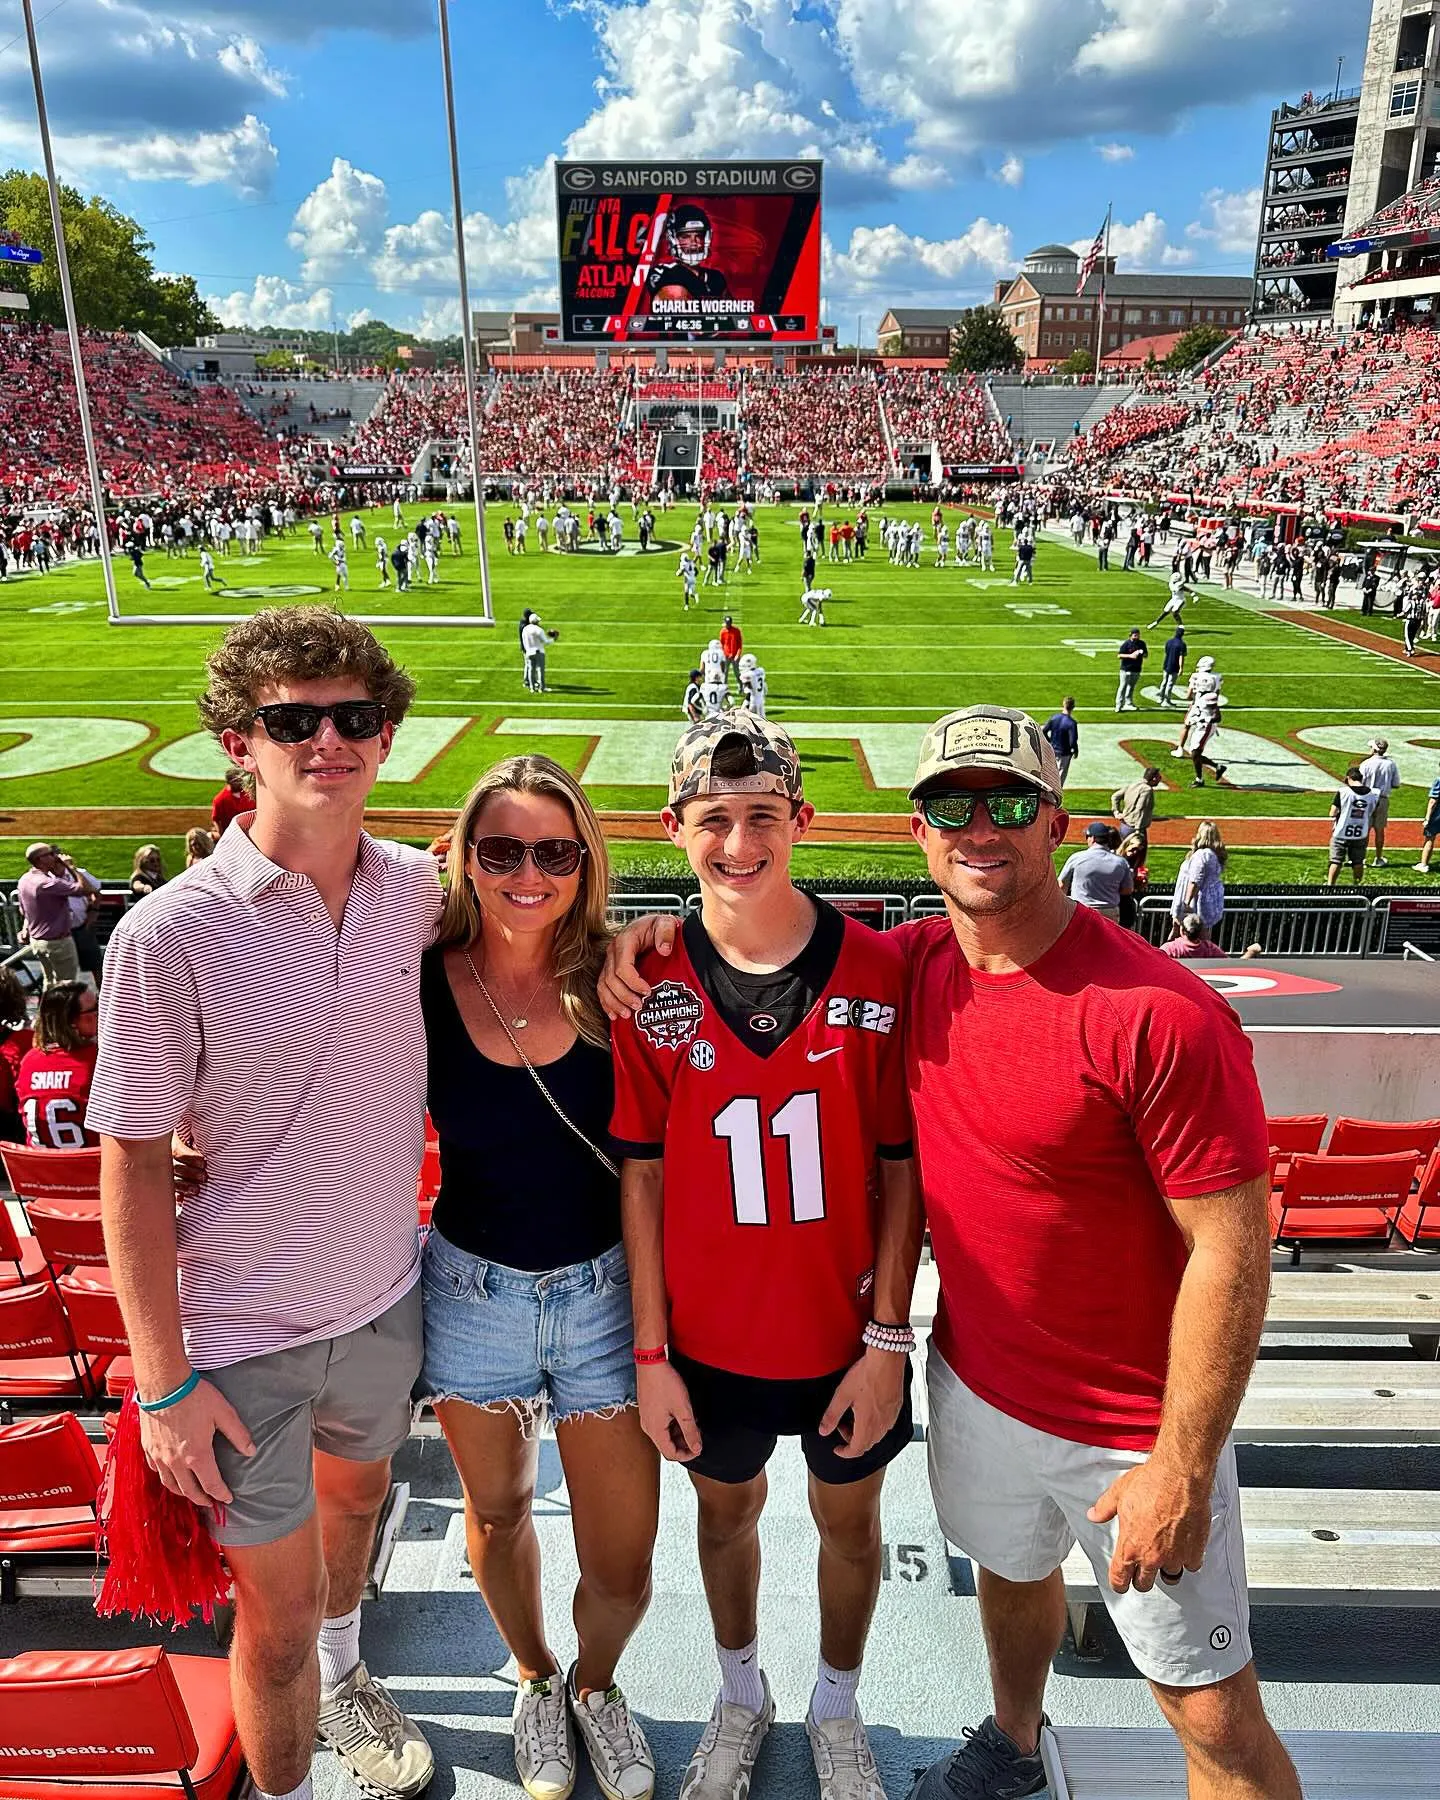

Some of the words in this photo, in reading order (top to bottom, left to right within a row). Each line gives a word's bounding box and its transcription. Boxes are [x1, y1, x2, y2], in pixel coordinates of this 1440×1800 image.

[602, 171, 687, 186] SANFORD
[696, 170, 776, 185] STADIUM
[568, 198, 620, 214] ATLANTA
[576, 287, 616, 298] FALCONS
[652, 299, 699, 313] CHARLIE
[701, 300, 755, 313] WOERNER
[758, 319, 766, 329] 0
[756, 677, 763, 692] 3
[1344, 825, 1362, 837] 66
[649, 997, 688, 1009] NATIONAL
[640, 1005, 699, 1025] CHAMPIONS
[691, 1043, 714, 1068] SEC
[30, 1071, 73, 1090] SMART
[23, 1098, 84, 1148] 16
[712, 1090, 827, 1225] 11
